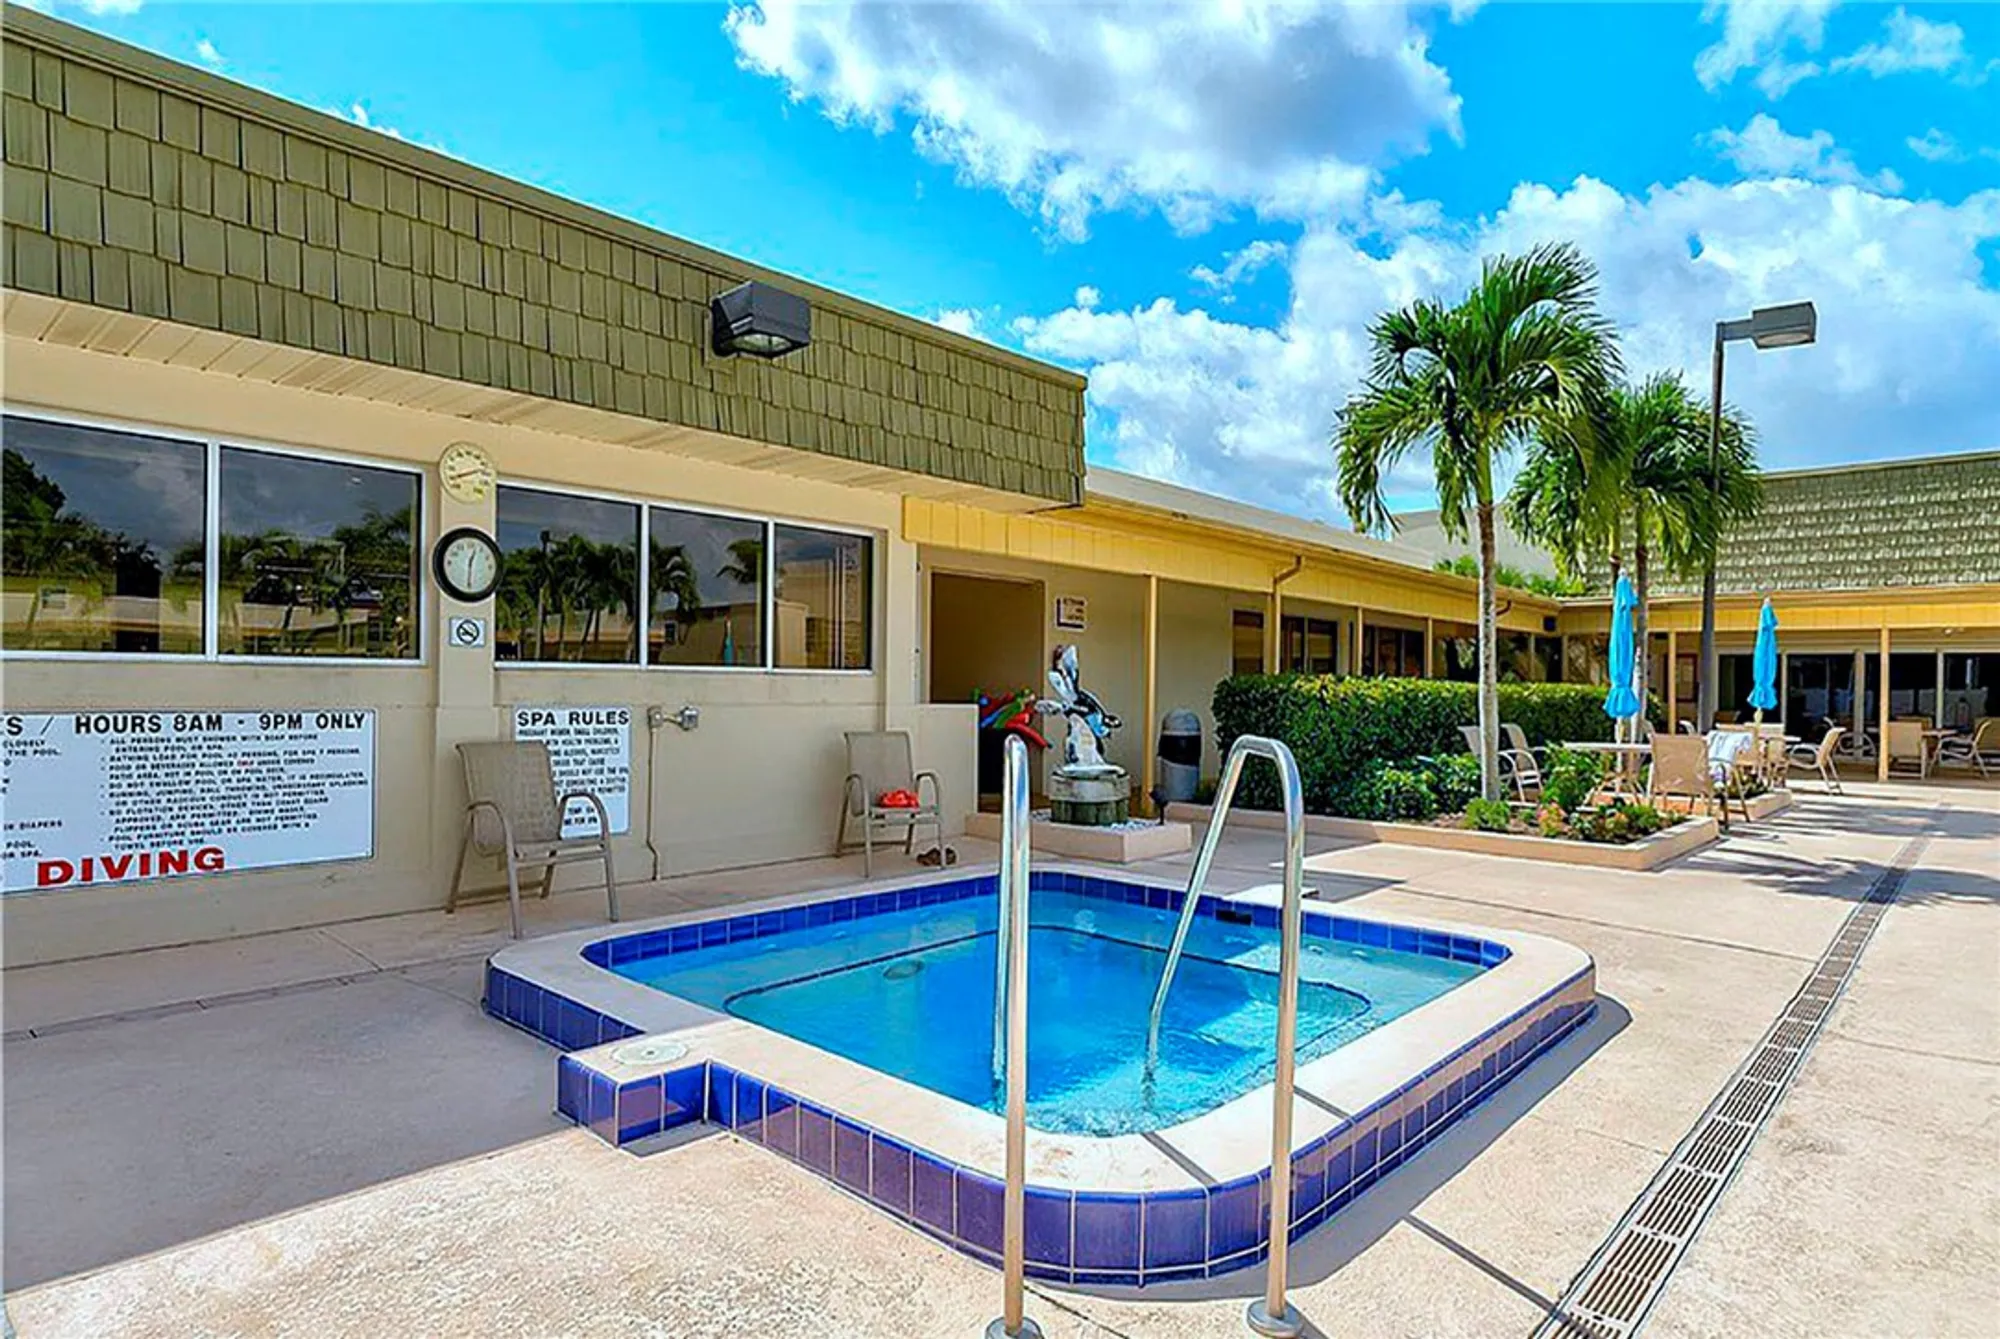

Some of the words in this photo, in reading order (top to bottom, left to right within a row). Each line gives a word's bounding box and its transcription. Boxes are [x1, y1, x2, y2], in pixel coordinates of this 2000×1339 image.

[75, 715, 162, 734] HOURS
[173, 714, 223, 733] 8AM
[259, 713, 303, 731] 9PM
[315, 713, 365, 730] ONLY
[517, 711, 556, 726] SPA
[569, 711, 629, 725] RULES
[37, 846, 225, 889] DIVING
